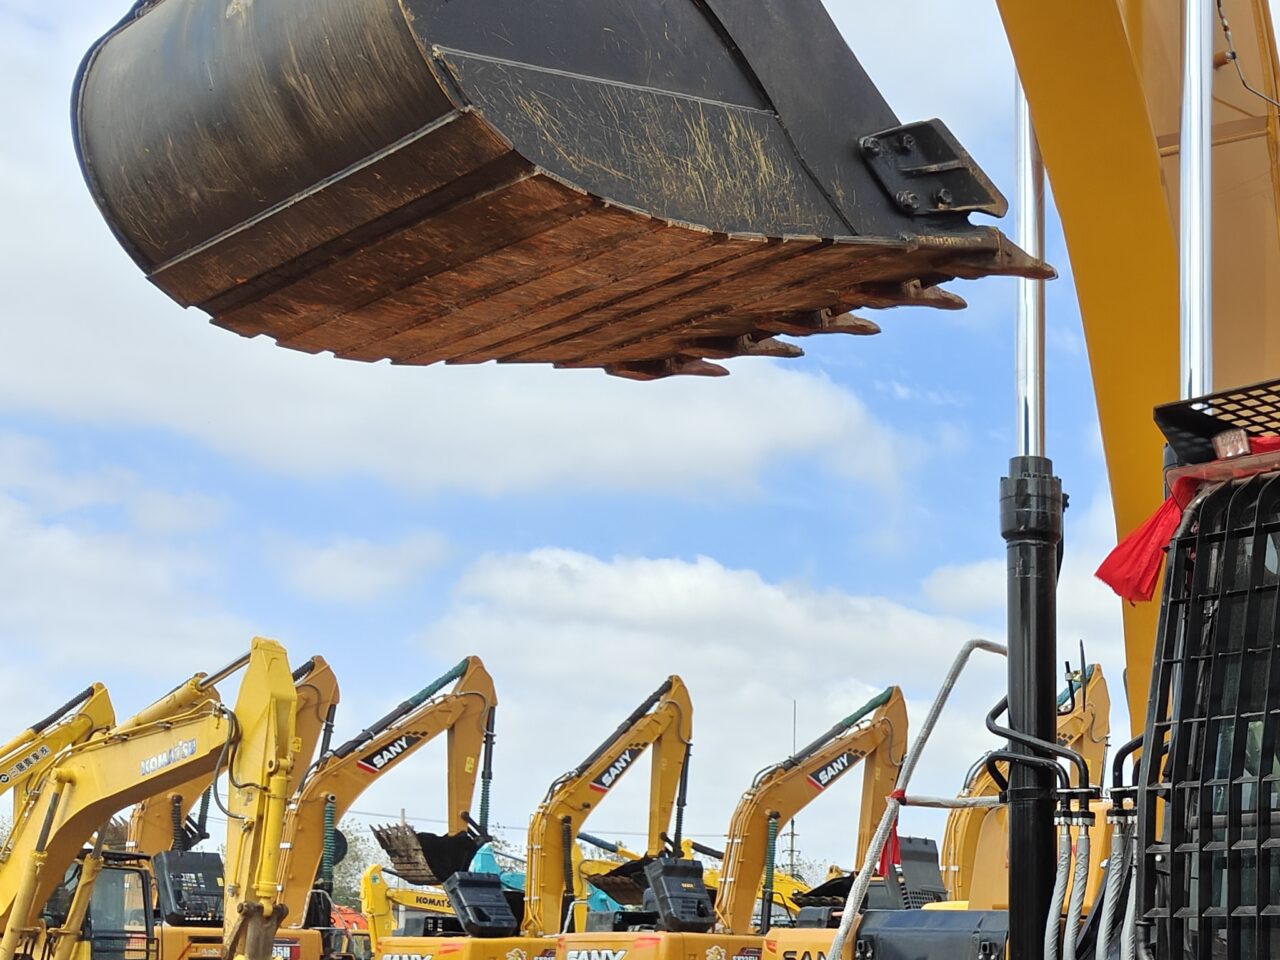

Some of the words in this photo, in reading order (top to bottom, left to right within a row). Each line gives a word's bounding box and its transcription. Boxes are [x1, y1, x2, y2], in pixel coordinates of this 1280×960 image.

[373, 736, 408, 769] SANY
[601, 749, 632, 787] SANY
[818, 753, 849, 785] SANY
[416, 895, 452, 908] KOMATS
